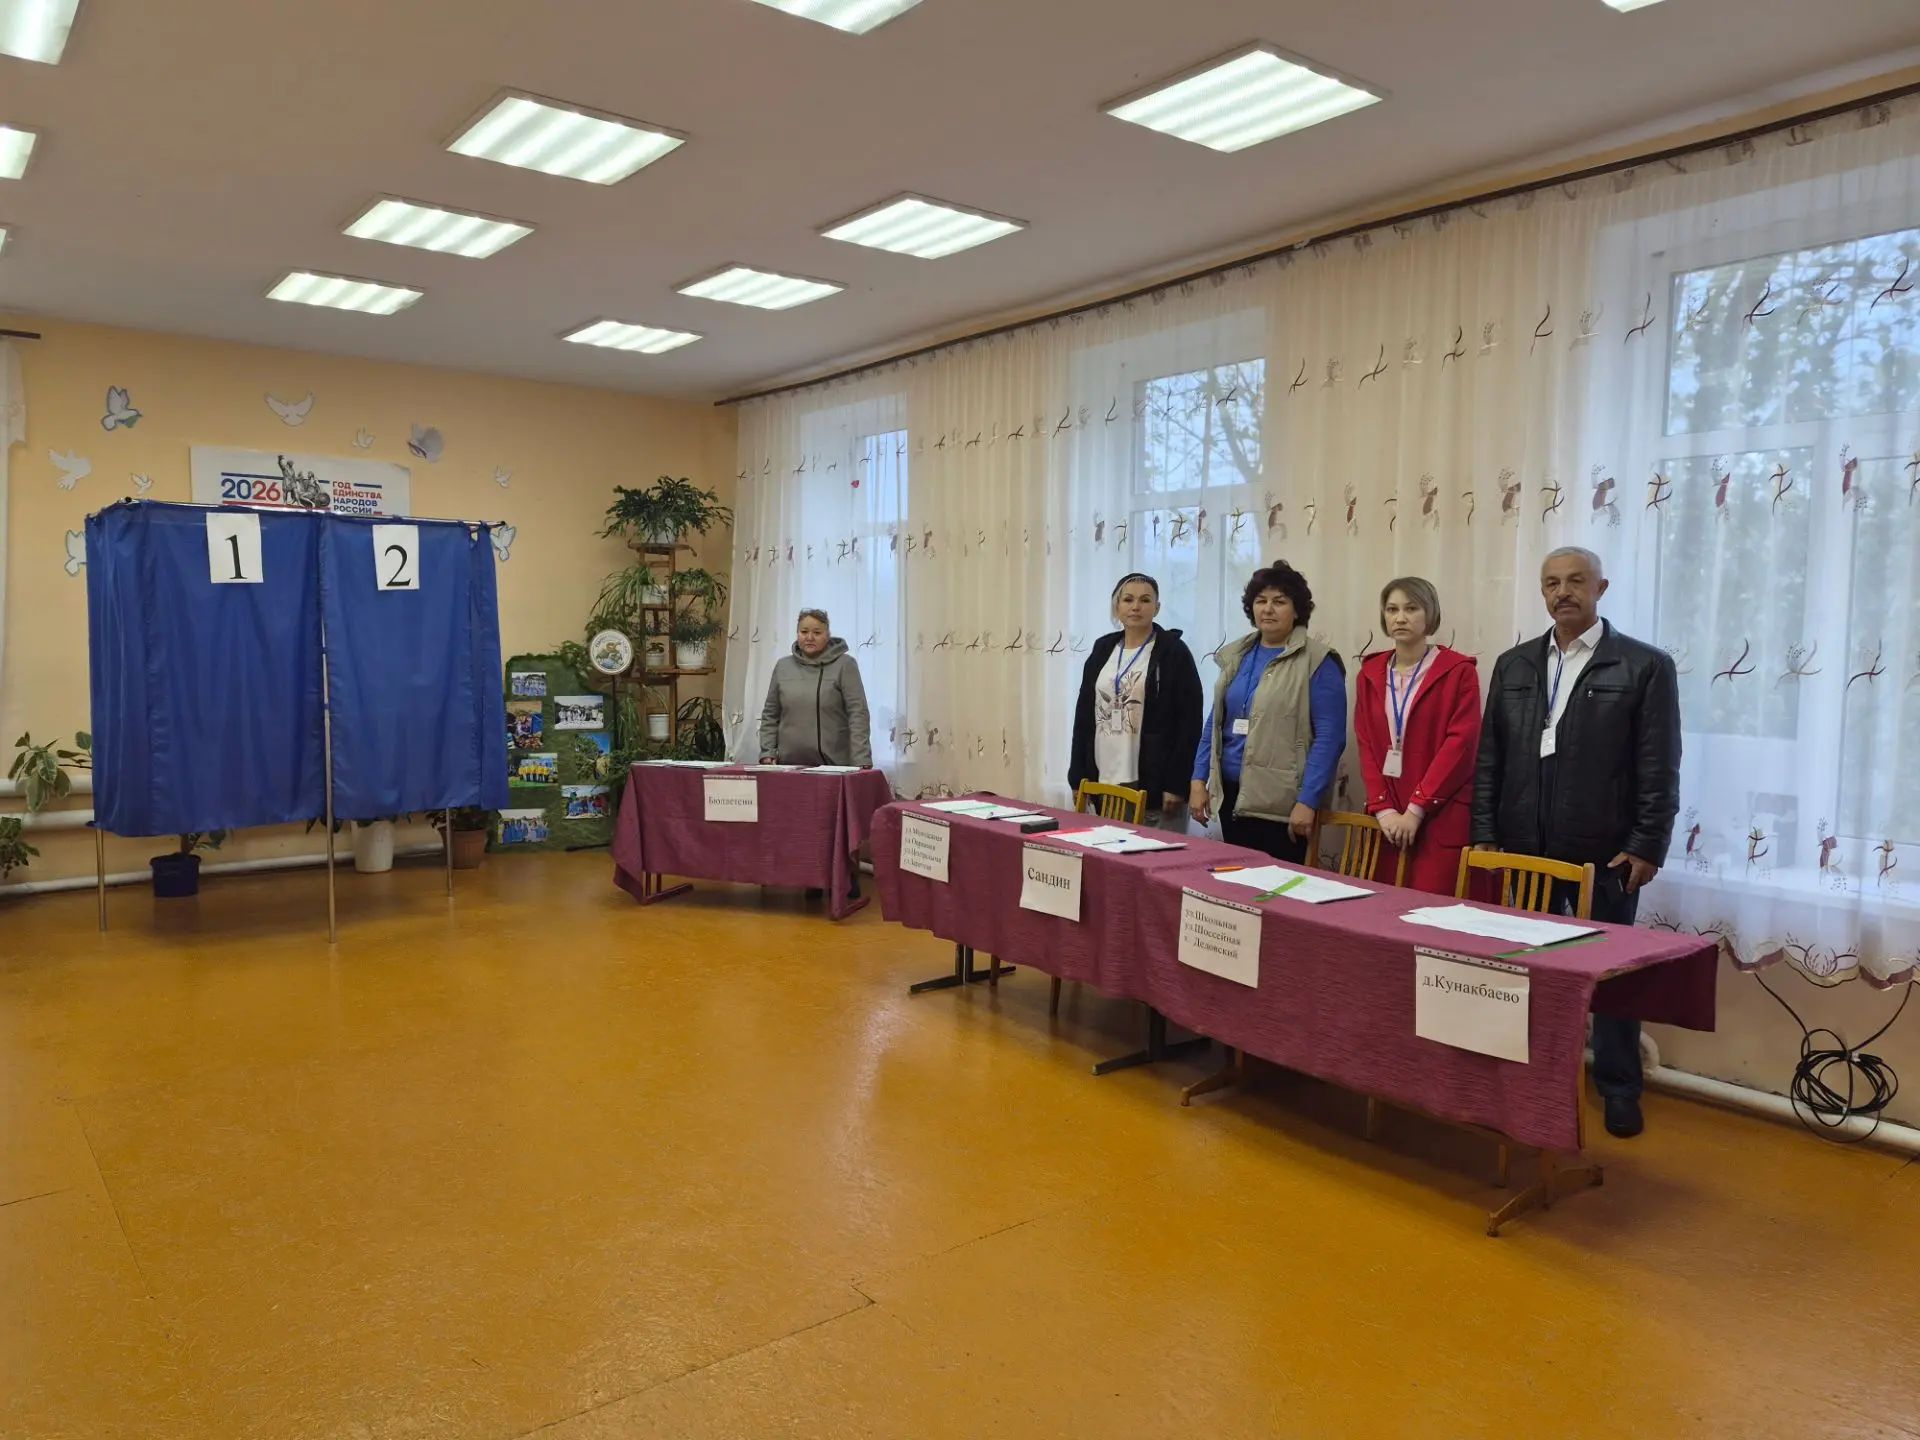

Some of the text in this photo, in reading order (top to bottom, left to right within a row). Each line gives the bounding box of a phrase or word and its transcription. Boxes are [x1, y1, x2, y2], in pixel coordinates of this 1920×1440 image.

[221, 478, 281, 502] 2026
[332, 481, 352, 489] ГОД
[332, 489, 382, 499] ЕДИНСТВА
[333, 497, 378, 507] НАРОДОВ
[333, 505, 372, 514] РОССИИ
[225, 534, 248, 580] 1
[384, 544, 412, 587] 2
[708, 796, 753, 806] Бюллетени
[1027, 867, 1071, 890] Сандин
[1422, 974, 1521, 1004] д.Кунакбаево
